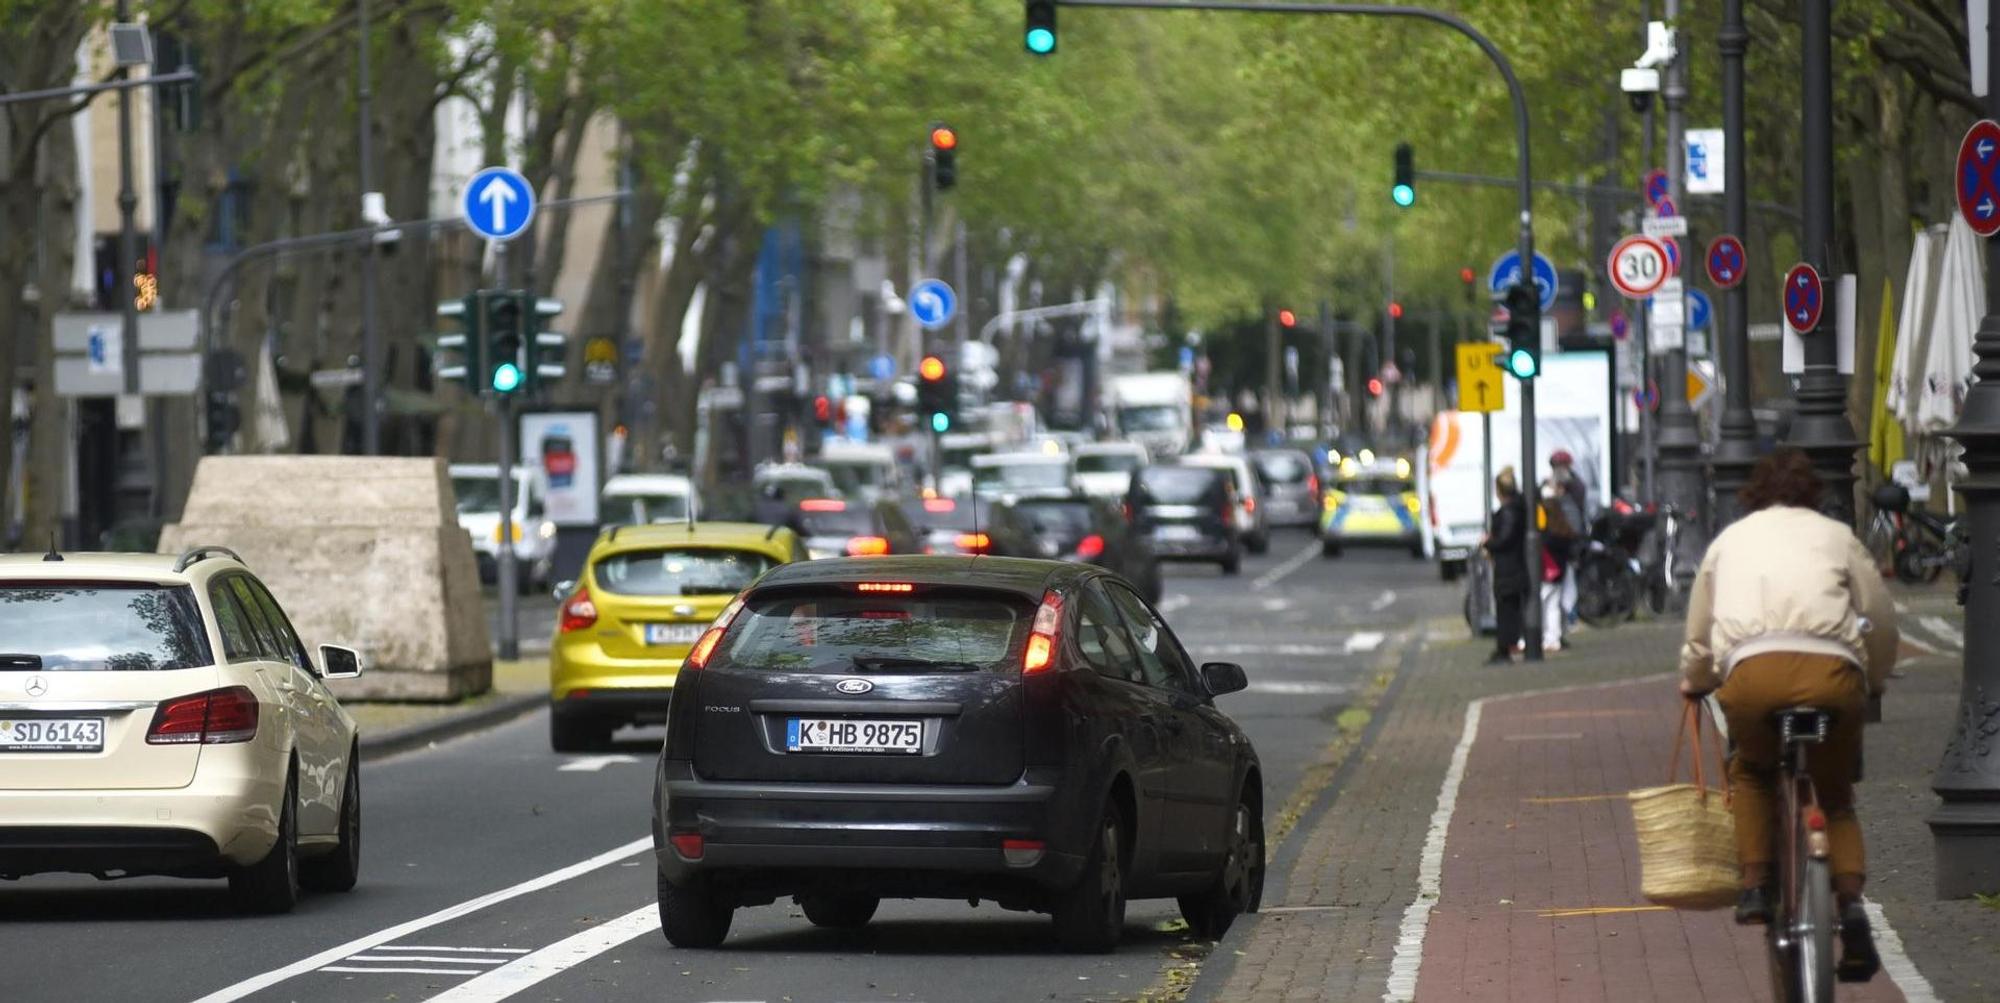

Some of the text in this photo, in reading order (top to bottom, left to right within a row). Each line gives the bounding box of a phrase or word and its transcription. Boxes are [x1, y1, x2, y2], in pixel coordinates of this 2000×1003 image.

[1623, 252, 1656, 279] 30
[14, 722, 99, 742] SD 6143
[790, 735, 796, 743] D
[800, 722, 918, 746] K HB 9875
